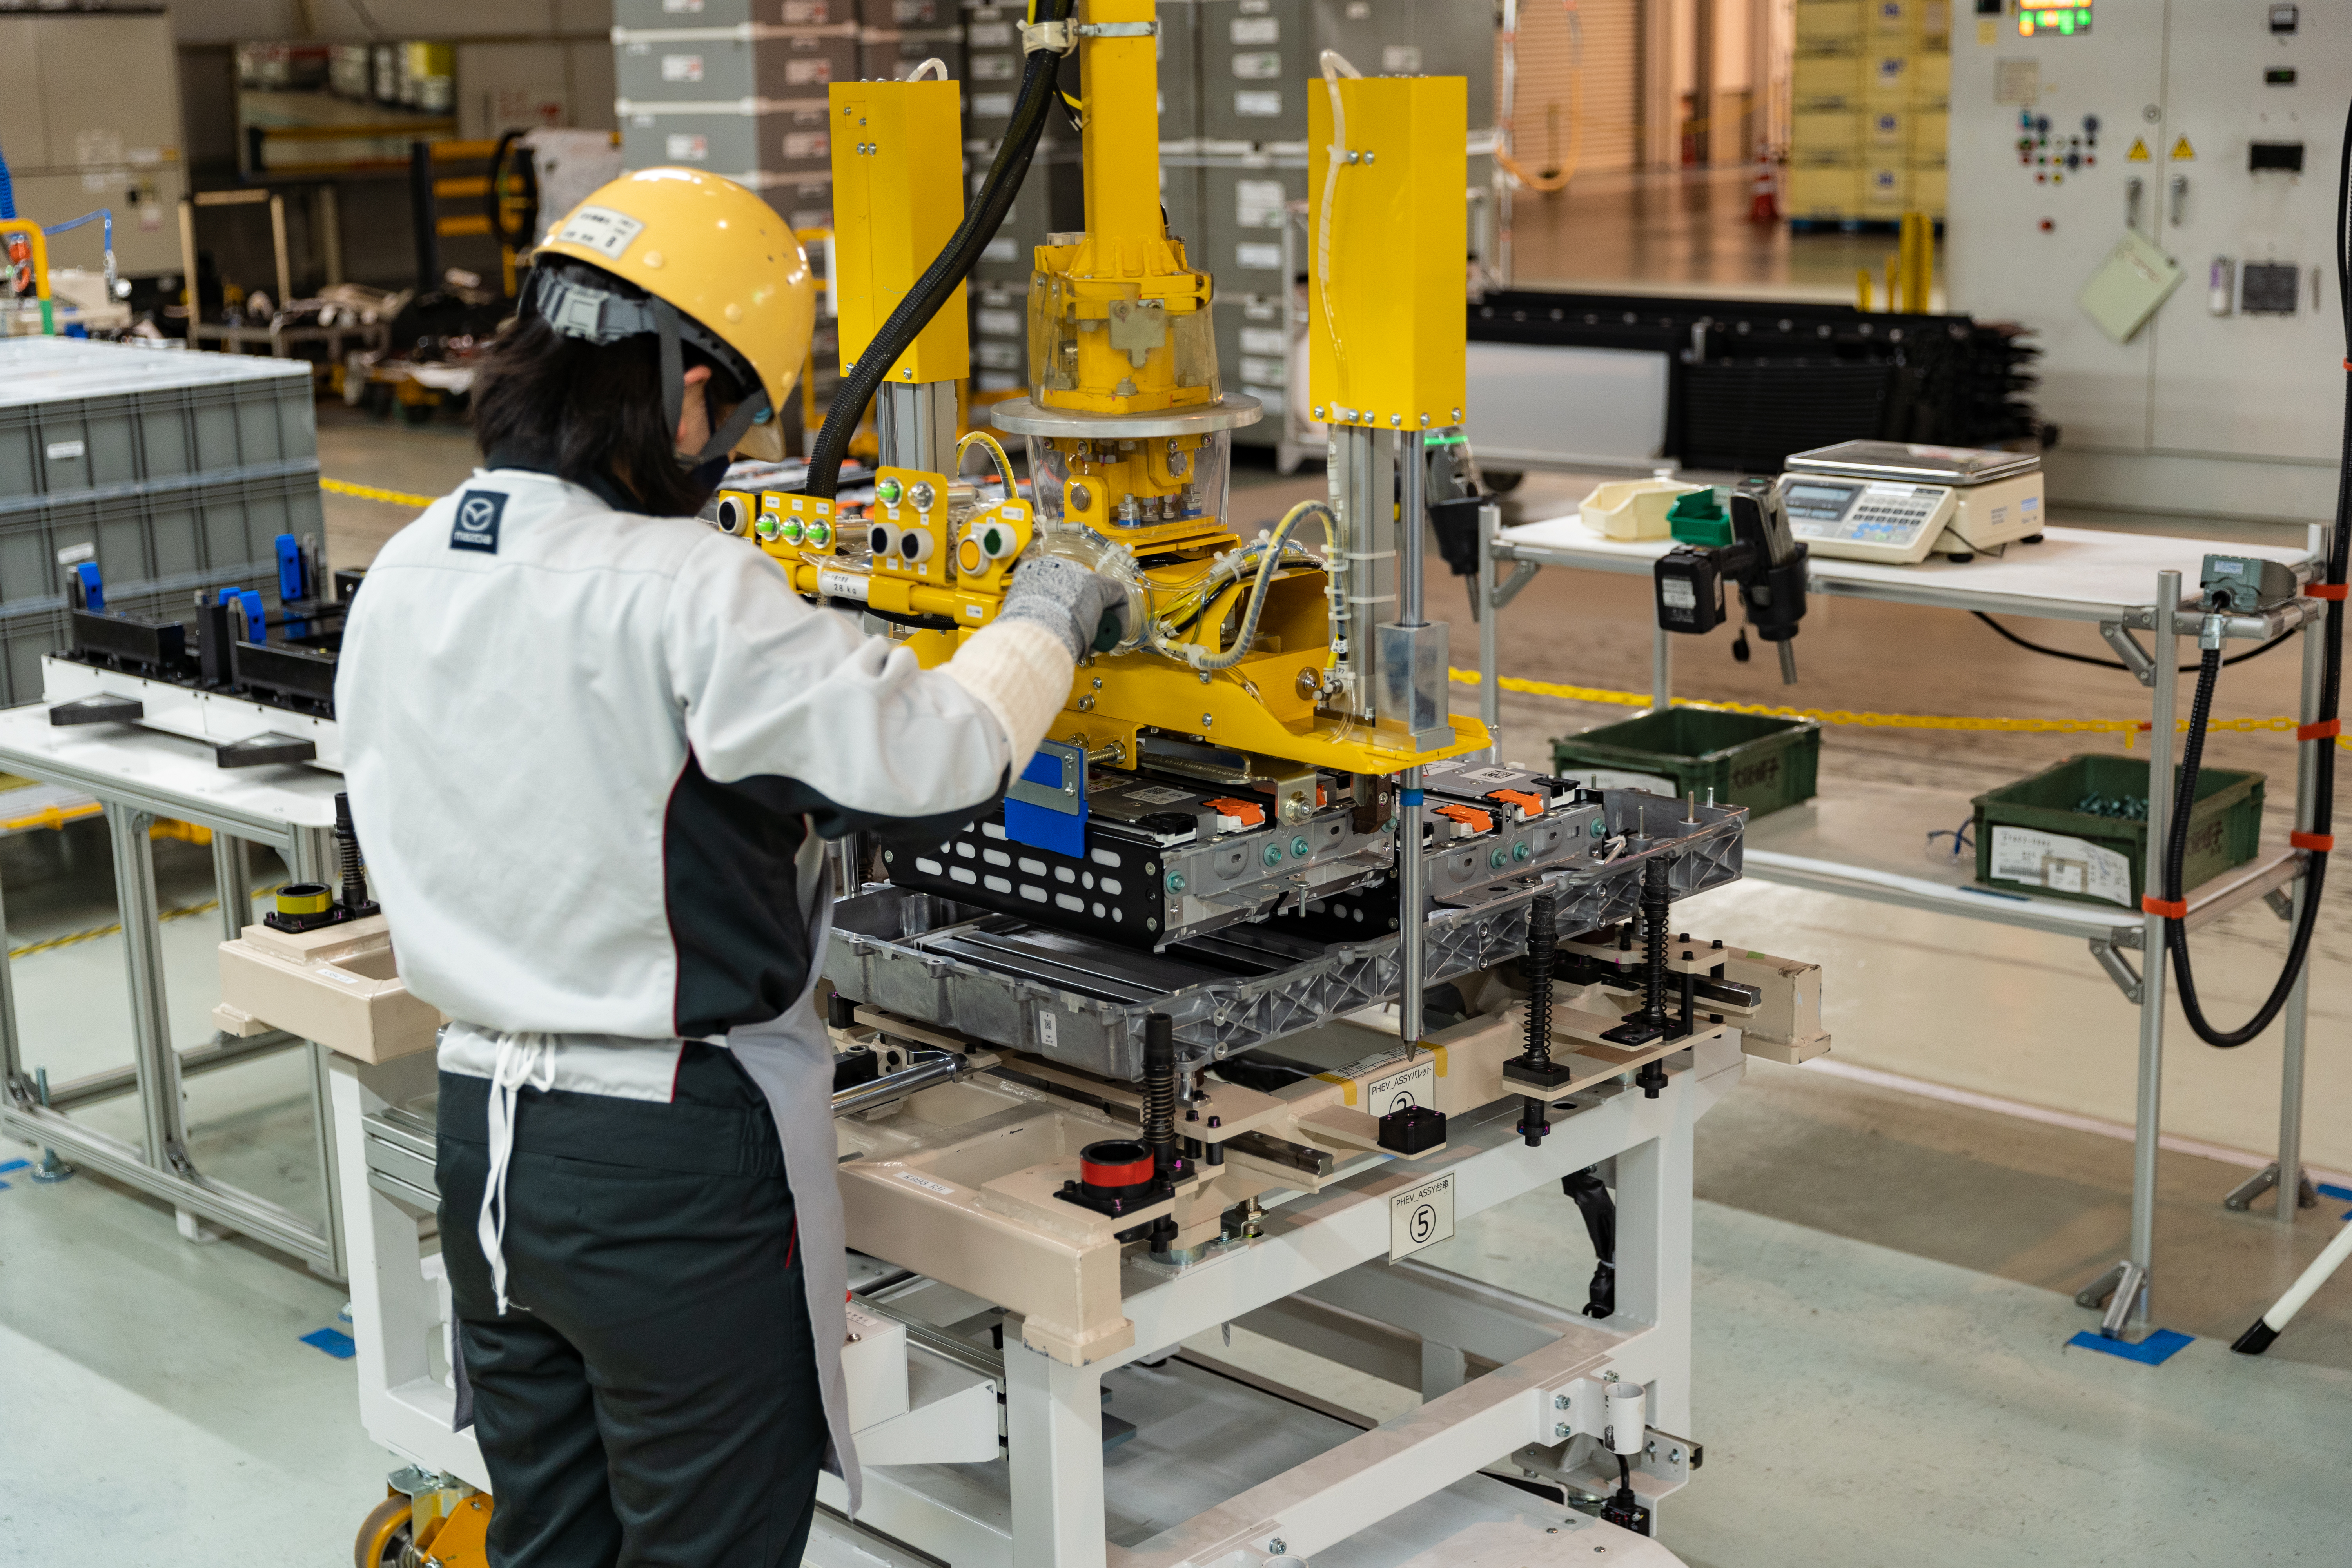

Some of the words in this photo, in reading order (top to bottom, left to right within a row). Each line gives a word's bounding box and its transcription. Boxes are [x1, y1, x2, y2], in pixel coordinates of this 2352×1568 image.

[454, 530, 493, 545] mazda
[833, 584, 843, 592] 28
[847, 586, 857, 595] kg
[1372, 1065, 1432, 1095] PHEV_ASSYパレット
[903, 1174, 929, 1186] KBB3
[1396, 1179, 1449, 1208] PHEV_ASSY台車
